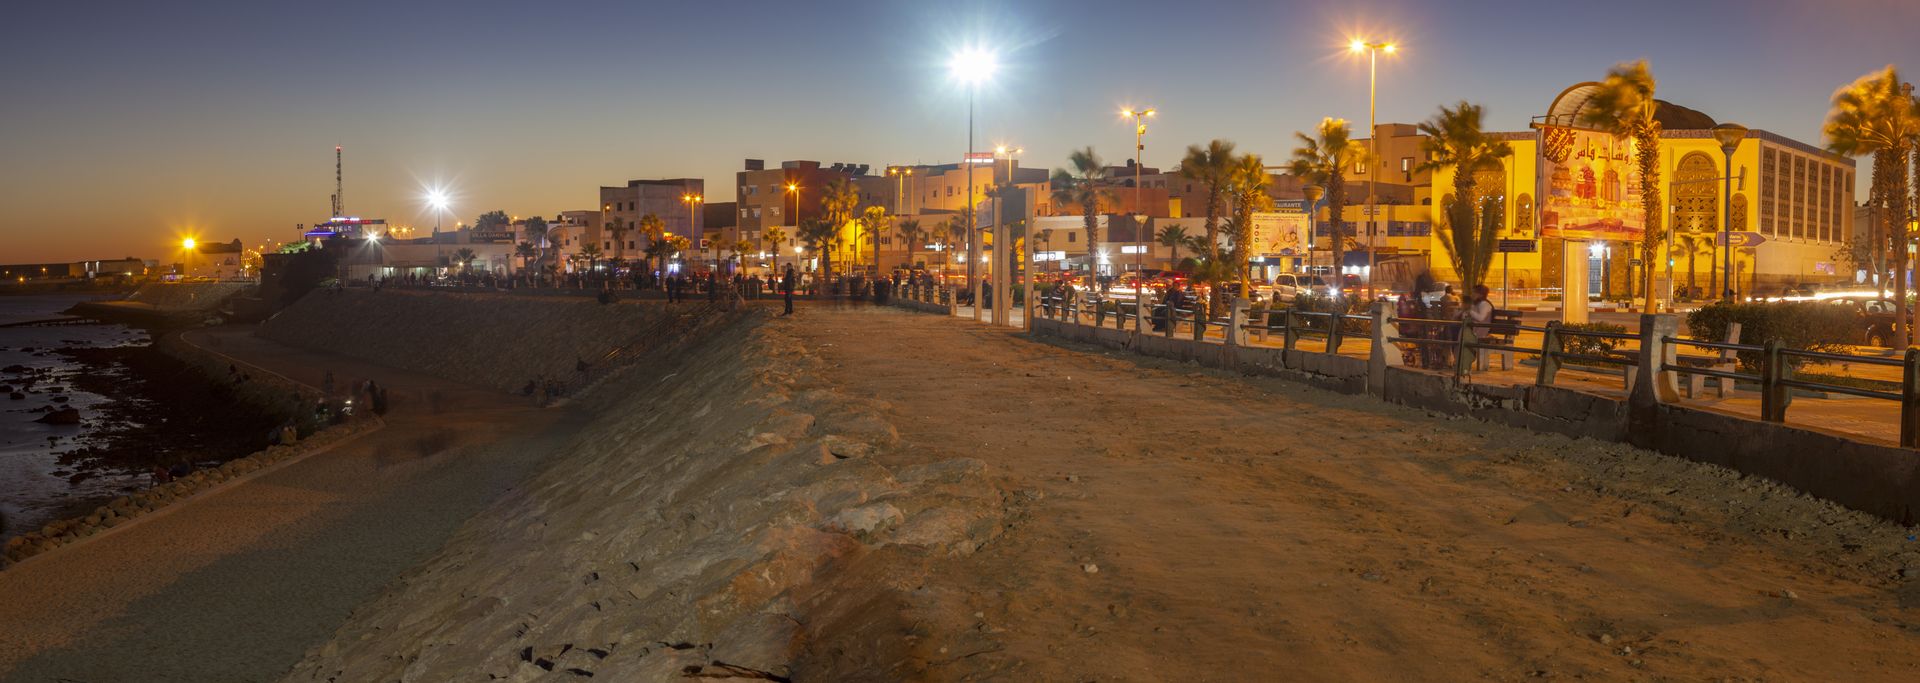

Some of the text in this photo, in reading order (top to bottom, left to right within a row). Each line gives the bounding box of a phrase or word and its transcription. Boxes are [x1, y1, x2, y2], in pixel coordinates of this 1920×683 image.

[1545, 128, 1559, 145] 2019
[1574, 136, 1595, 161] فاس
[1597, 136, 1632, 165] روشات
